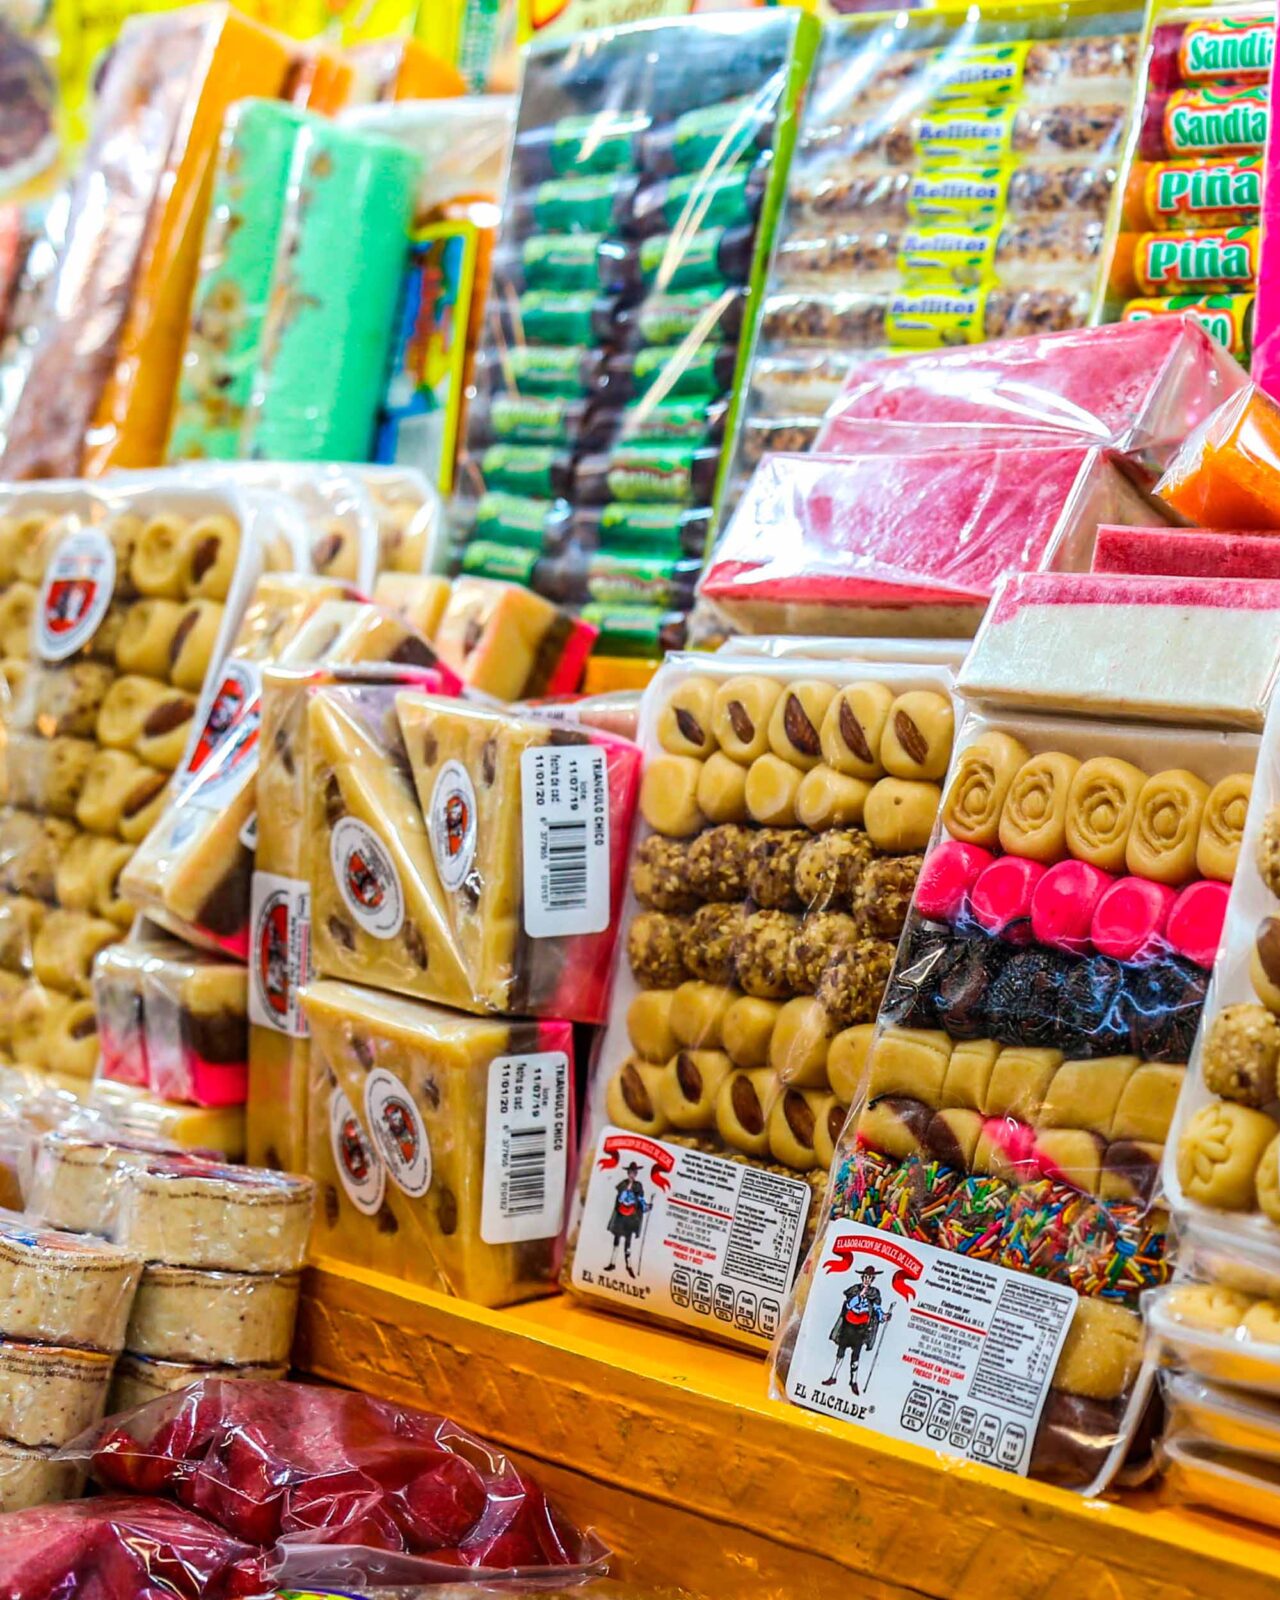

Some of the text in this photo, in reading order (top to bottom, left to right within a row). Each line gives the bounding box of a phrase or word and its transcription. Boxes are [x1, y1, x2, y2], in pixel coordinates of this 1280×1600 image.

[1159, 167, 1260, 209] Piña
[1149, 239, 1249, 279] Piña
[535, 755, 544, 805] 11/01/20
[550, 777, 560, 786] de
[569, 760, 577, 810] 11/07/19
[592, 758, 603, 846] TRIANGULO CHICO
[500, 1064, 510, 1113] 11/01/20
[514, 1085, 524, 1094] de
[531, 1067, 541, 1117] 11/07/19
[553, 1063, 565, 1151] TRIANGULO CHICO
[836, 1239, 874, 1249] ELABORACION
[904, 1258, 922, 1275] LECHE
[582, 1269, 594, 1284] EL
[901, 1353, 935, 1371] MANTENGASE
[949, 1369, 965, 1381] LUGAR
[912, 1367, 932, 1380] FRESCO
[794, 1383, 807, 1400] EL
[1001, 1450, 1016, 1461] Kcal
